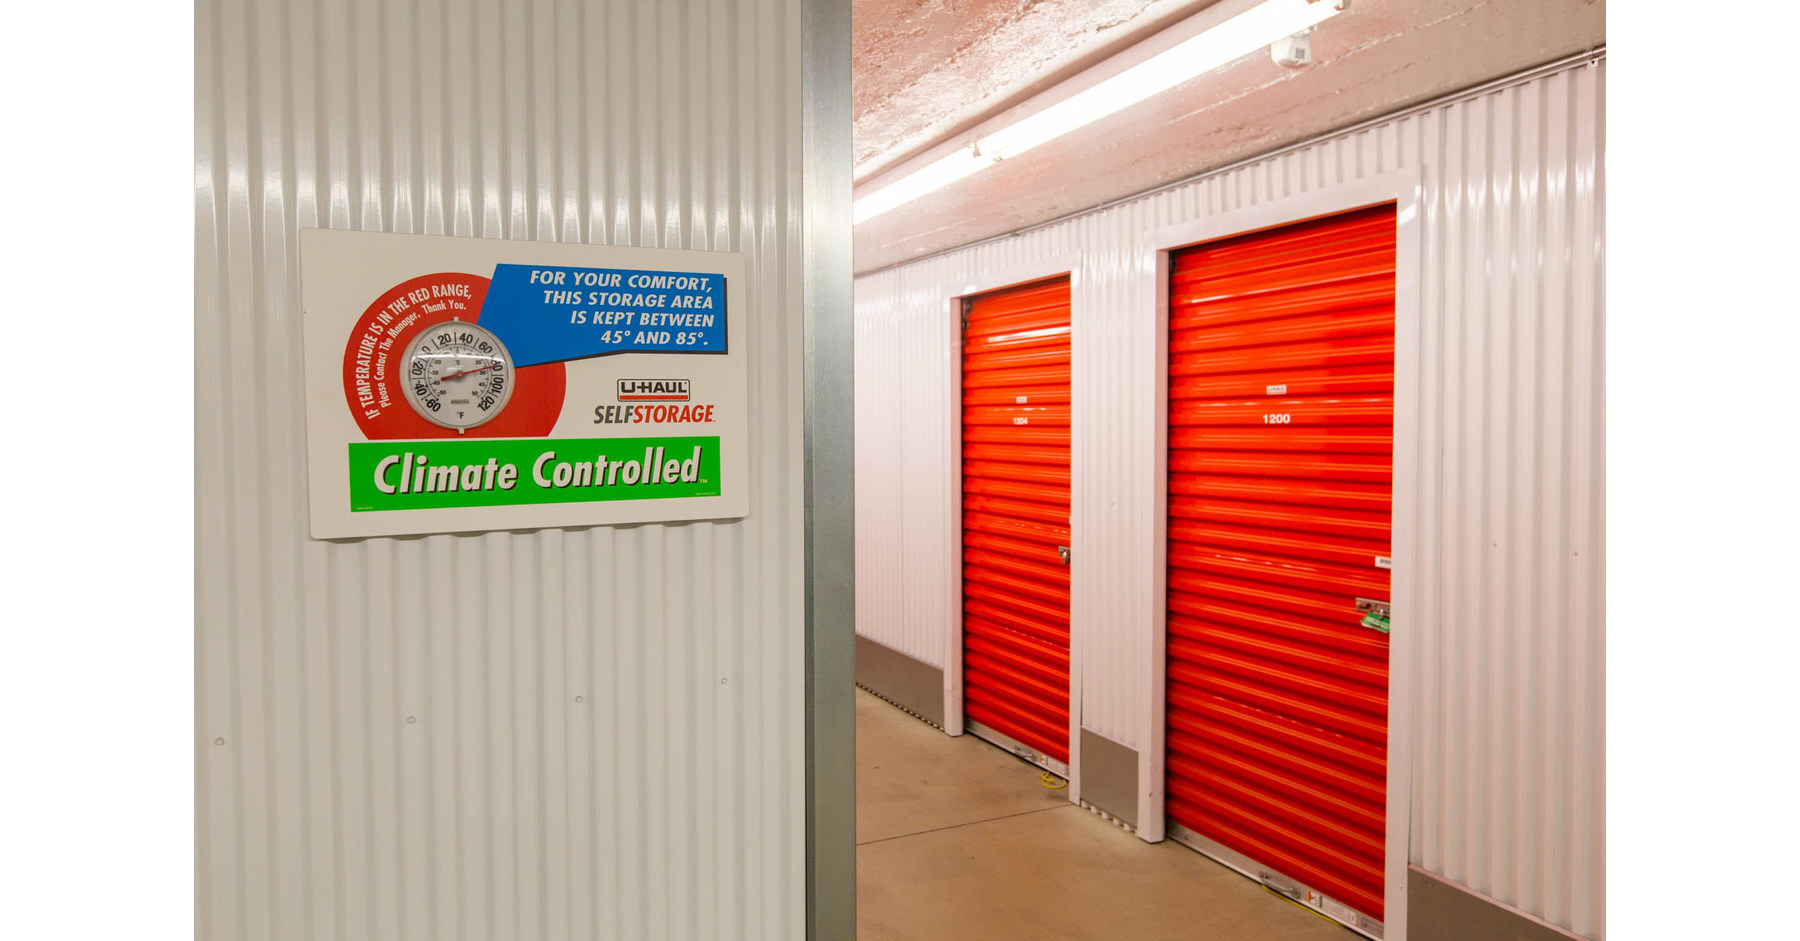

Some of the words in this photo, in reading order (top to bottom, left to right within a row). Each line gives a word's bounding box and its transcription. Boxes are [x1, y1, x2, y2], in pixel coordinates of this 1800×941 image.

[530, 270, 566, 285] FOR
[573, 271, 622, 287] YOUR
[628, 274, 713, 293] COMFORT,
[407, 287, 431, 305] RED
[431, 283, 472, 300] RANGE,
[543, 290, 582, 305] THIS
[588, 291, 667, 308] STORAGE
[670, 295, 713, 309] AREA
[387, 296, 411, 316] THE
[421, 300, 447, 315] Thank
[448, 299, 467, 311] You.
[376, 310, 394, 326] IN
[387, 311, 421, 339] Manager.
[570, 310, 587, 324] IS
[592, 311, 635, 326] KEPT
[639, 312, 715, 328] BETWEEN
[368, 322, 384, 336] IS
[378, 337, 394, 352] The
[437, 333, 452, 346] 20
[459, 332, 474, 344] 40
[600, 330, 631, 344] 45°
[633, 331, 671, 345] AND
[675, 331, 709, 346] 85°.
[478, 341, 493, 354] 60
[355, 333, 378, 408] TEMPERATURE
[373, 351, 388, 381] Contact
[414, 380, 427, 396] -40
[491, 376, 504, 394] 100
[620, 381, 688, 393] U-HAUL
[378, 382, 392, 409] Please
[477, 395, 495, 411] 120
[425, 398, 441, 412] -60
[365, 408, 381, 420] IF
[1262, 413, 1291, 424] 1200
[373, 451, 519, 495] Climate
[532, 445, 702, 488] Controlled
